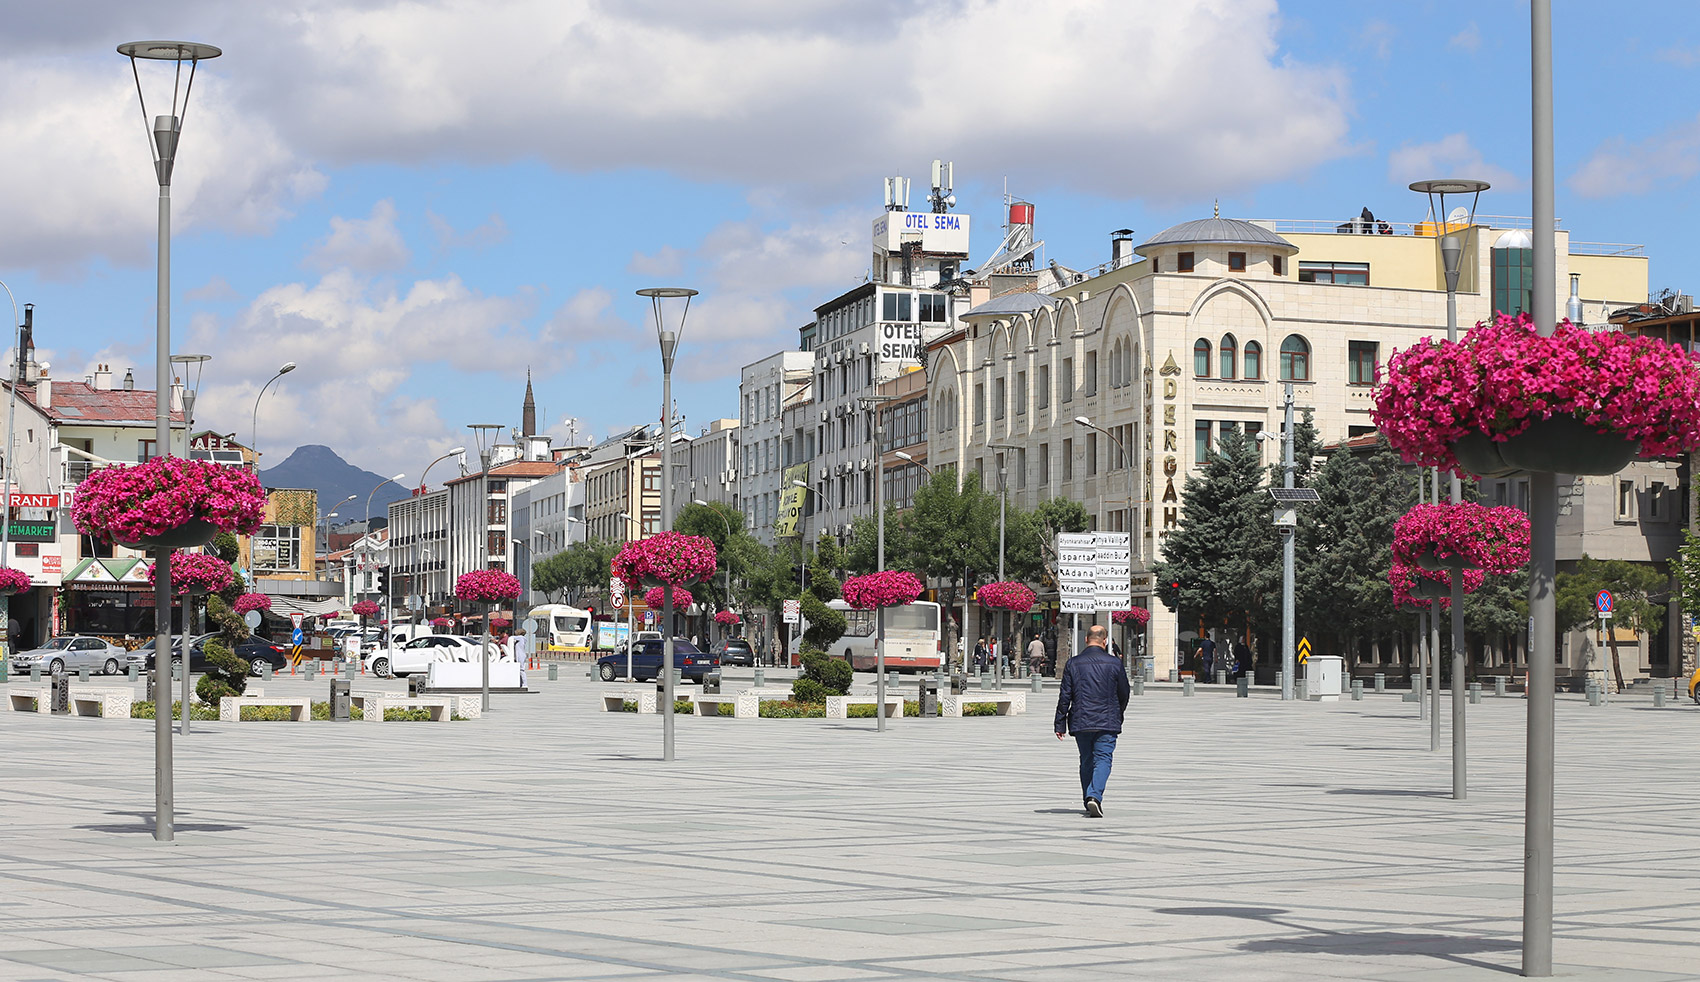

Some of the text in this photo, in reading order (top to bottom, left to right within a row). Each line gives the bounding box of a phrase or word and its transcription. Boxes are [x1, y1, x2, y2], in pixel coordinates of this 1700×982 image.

[906, 214, 960, 230] OTEL SEMA
[884, 324, 921, 339] OTEL
[190, 437, 229, 451] AFE
[0, 495, 53, 507] RANT
[1059, 553, 1091, 562] Isparta
[1065, 569, 1094, 577] Adana
[1111, 567, 1123, 575] Park
[1066, 585, 1095, 593] Karaman
[1066, 601, 1095, 611] Antalya
